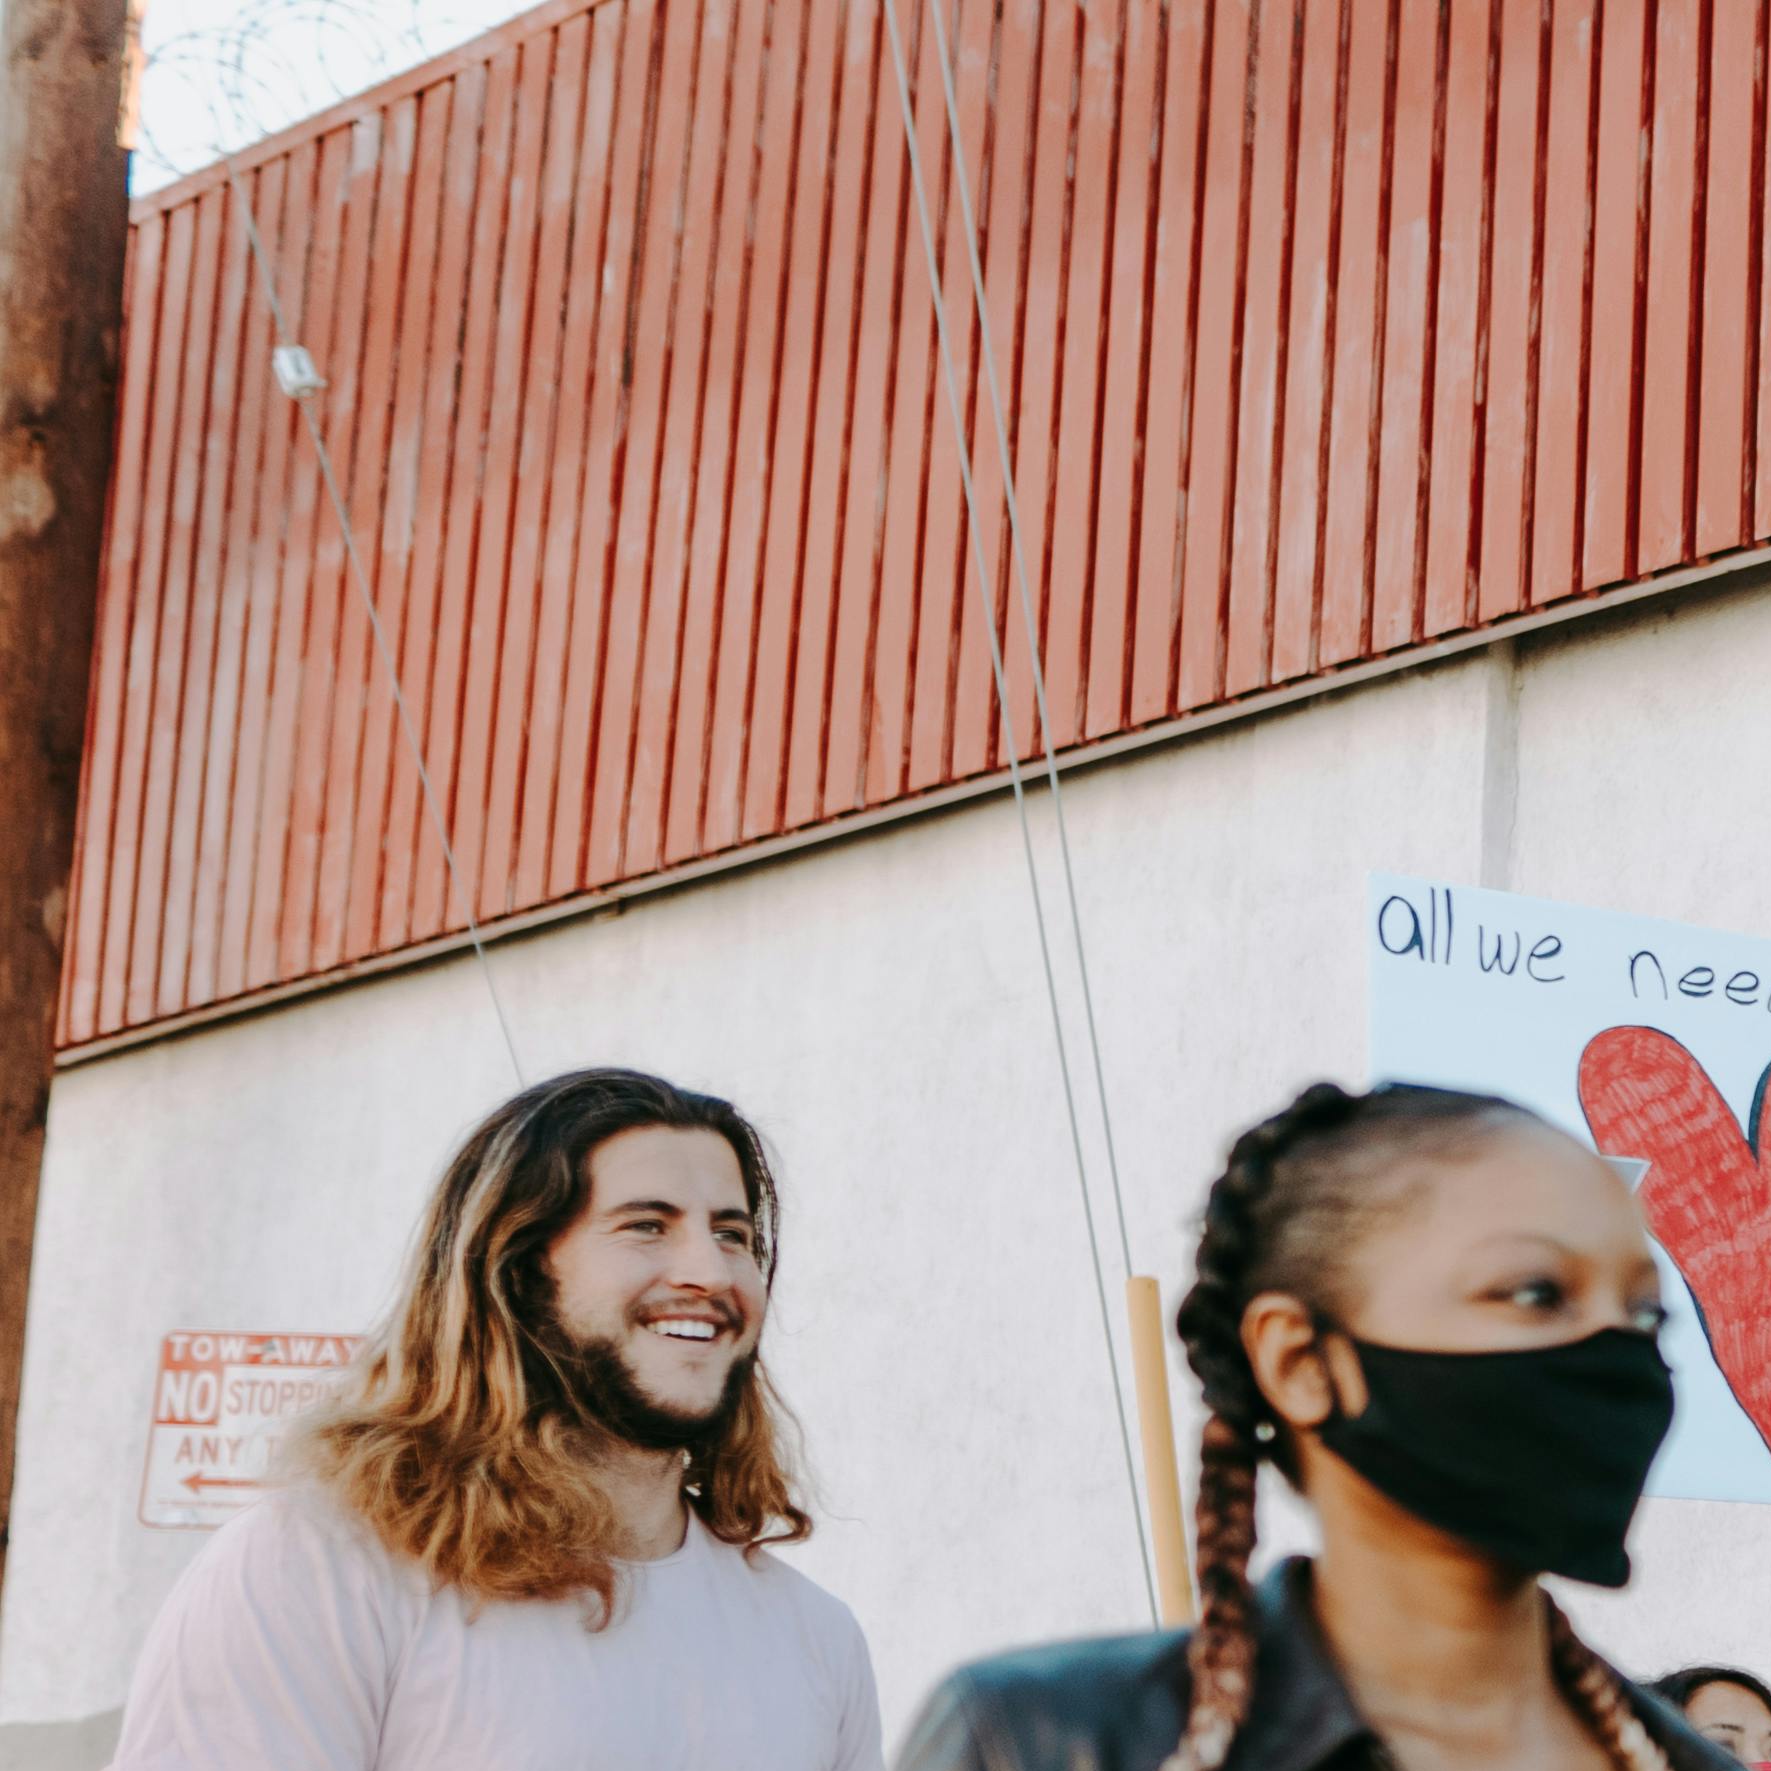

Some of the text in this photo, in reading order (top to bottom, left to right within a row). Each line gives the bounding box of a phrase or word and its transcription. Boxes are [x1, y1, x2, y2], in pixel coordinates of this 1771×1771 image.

[1377, 887, 1453, 966] all
[1478, 924, 1566, 984] we
[157, 1369, 341, 1422] NO STOPPIN
[174, 1436, 244, 1466] ANY
